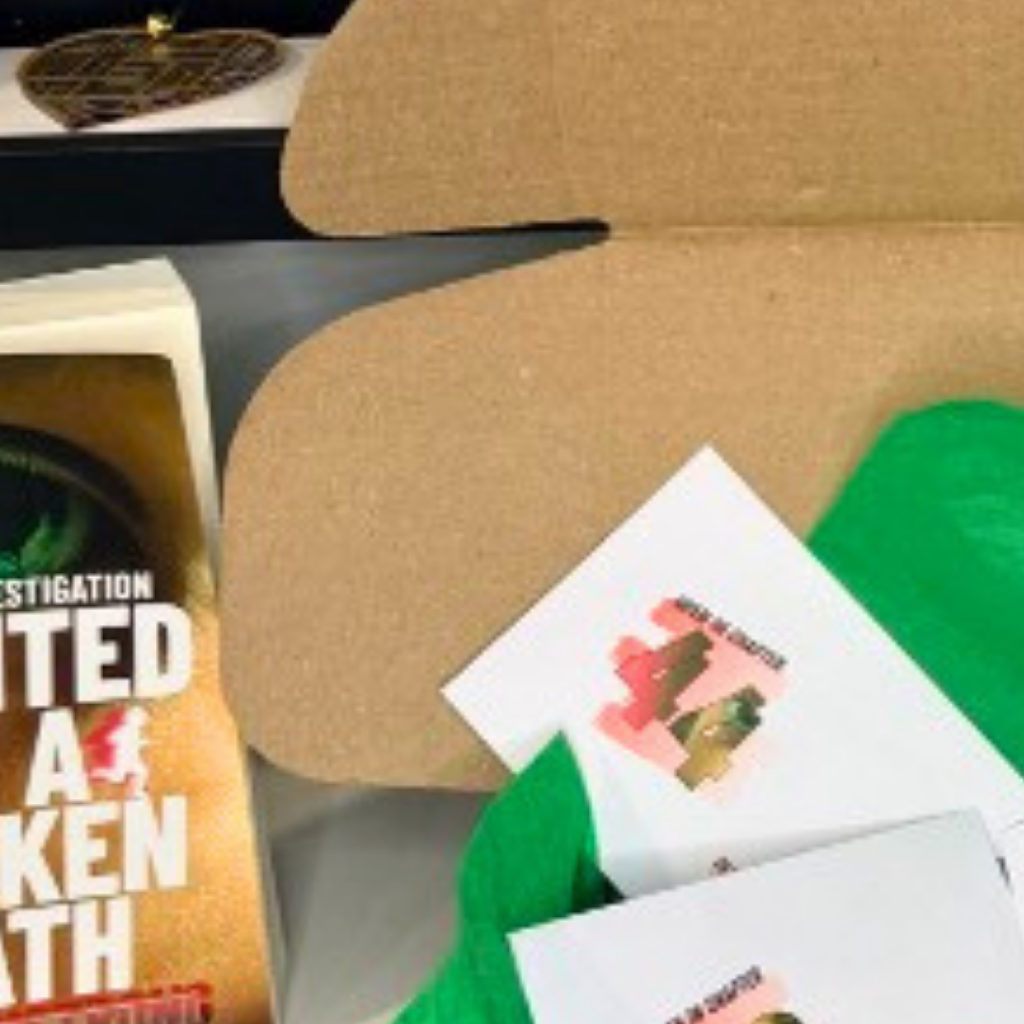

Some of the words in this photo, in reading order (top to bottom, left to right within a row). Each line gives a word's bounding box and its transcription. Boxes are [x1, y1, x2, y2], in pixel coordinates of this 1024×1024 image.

[0, 571, 154, 609] STIGATION
[0, 602, 194, 714] TED
[24, 706, 92, 808] A
[0, 795, 189, 906] KEN
